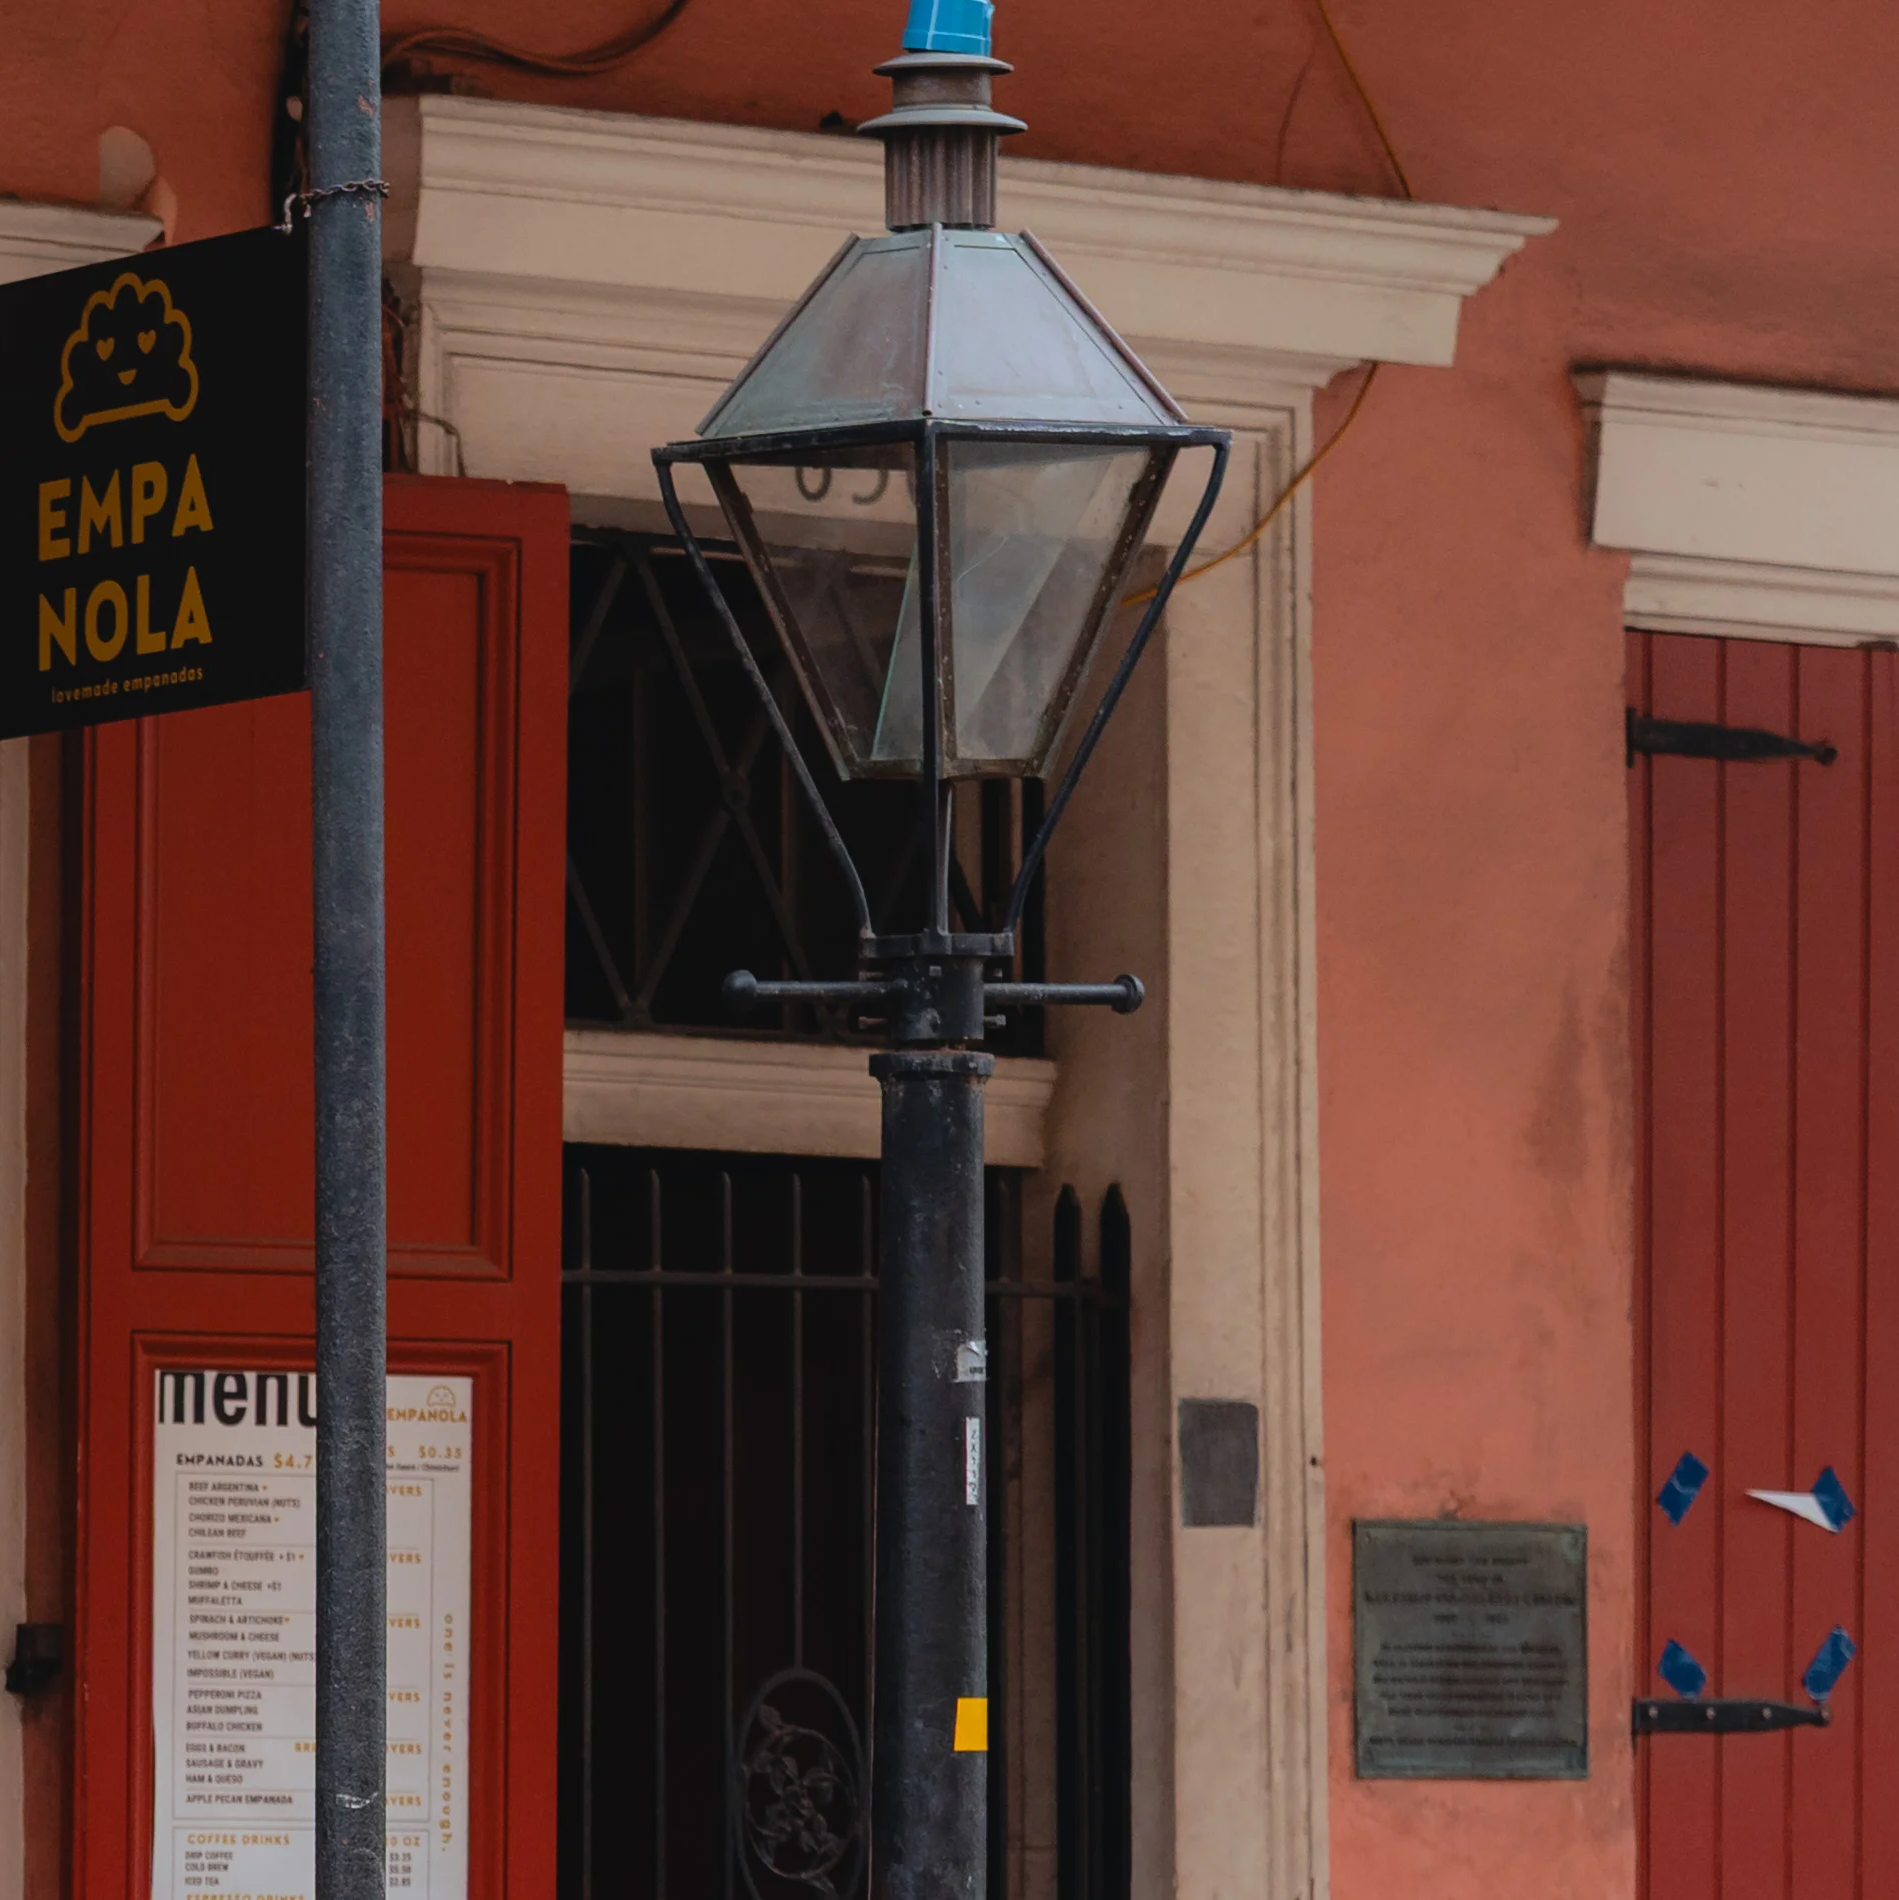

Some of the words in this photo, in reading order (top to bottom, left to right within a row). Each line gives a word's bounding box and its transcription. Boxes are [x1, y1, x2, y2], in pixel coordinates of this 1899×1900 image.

[39, 454, 214, 561] EMPA
[39, 566, 213, 671] NOLA
[52, 678, 118, 704] lovemade
[123, 666, 203, 693] empanadas
[387, 1408, 467, 1423] EMPANOLA
[177, 1454, 263, 1466] EMPANADAS
[187, 1834, 236, 1845] COFFEE
[242, 1834, 289, 1845] DRINKS
